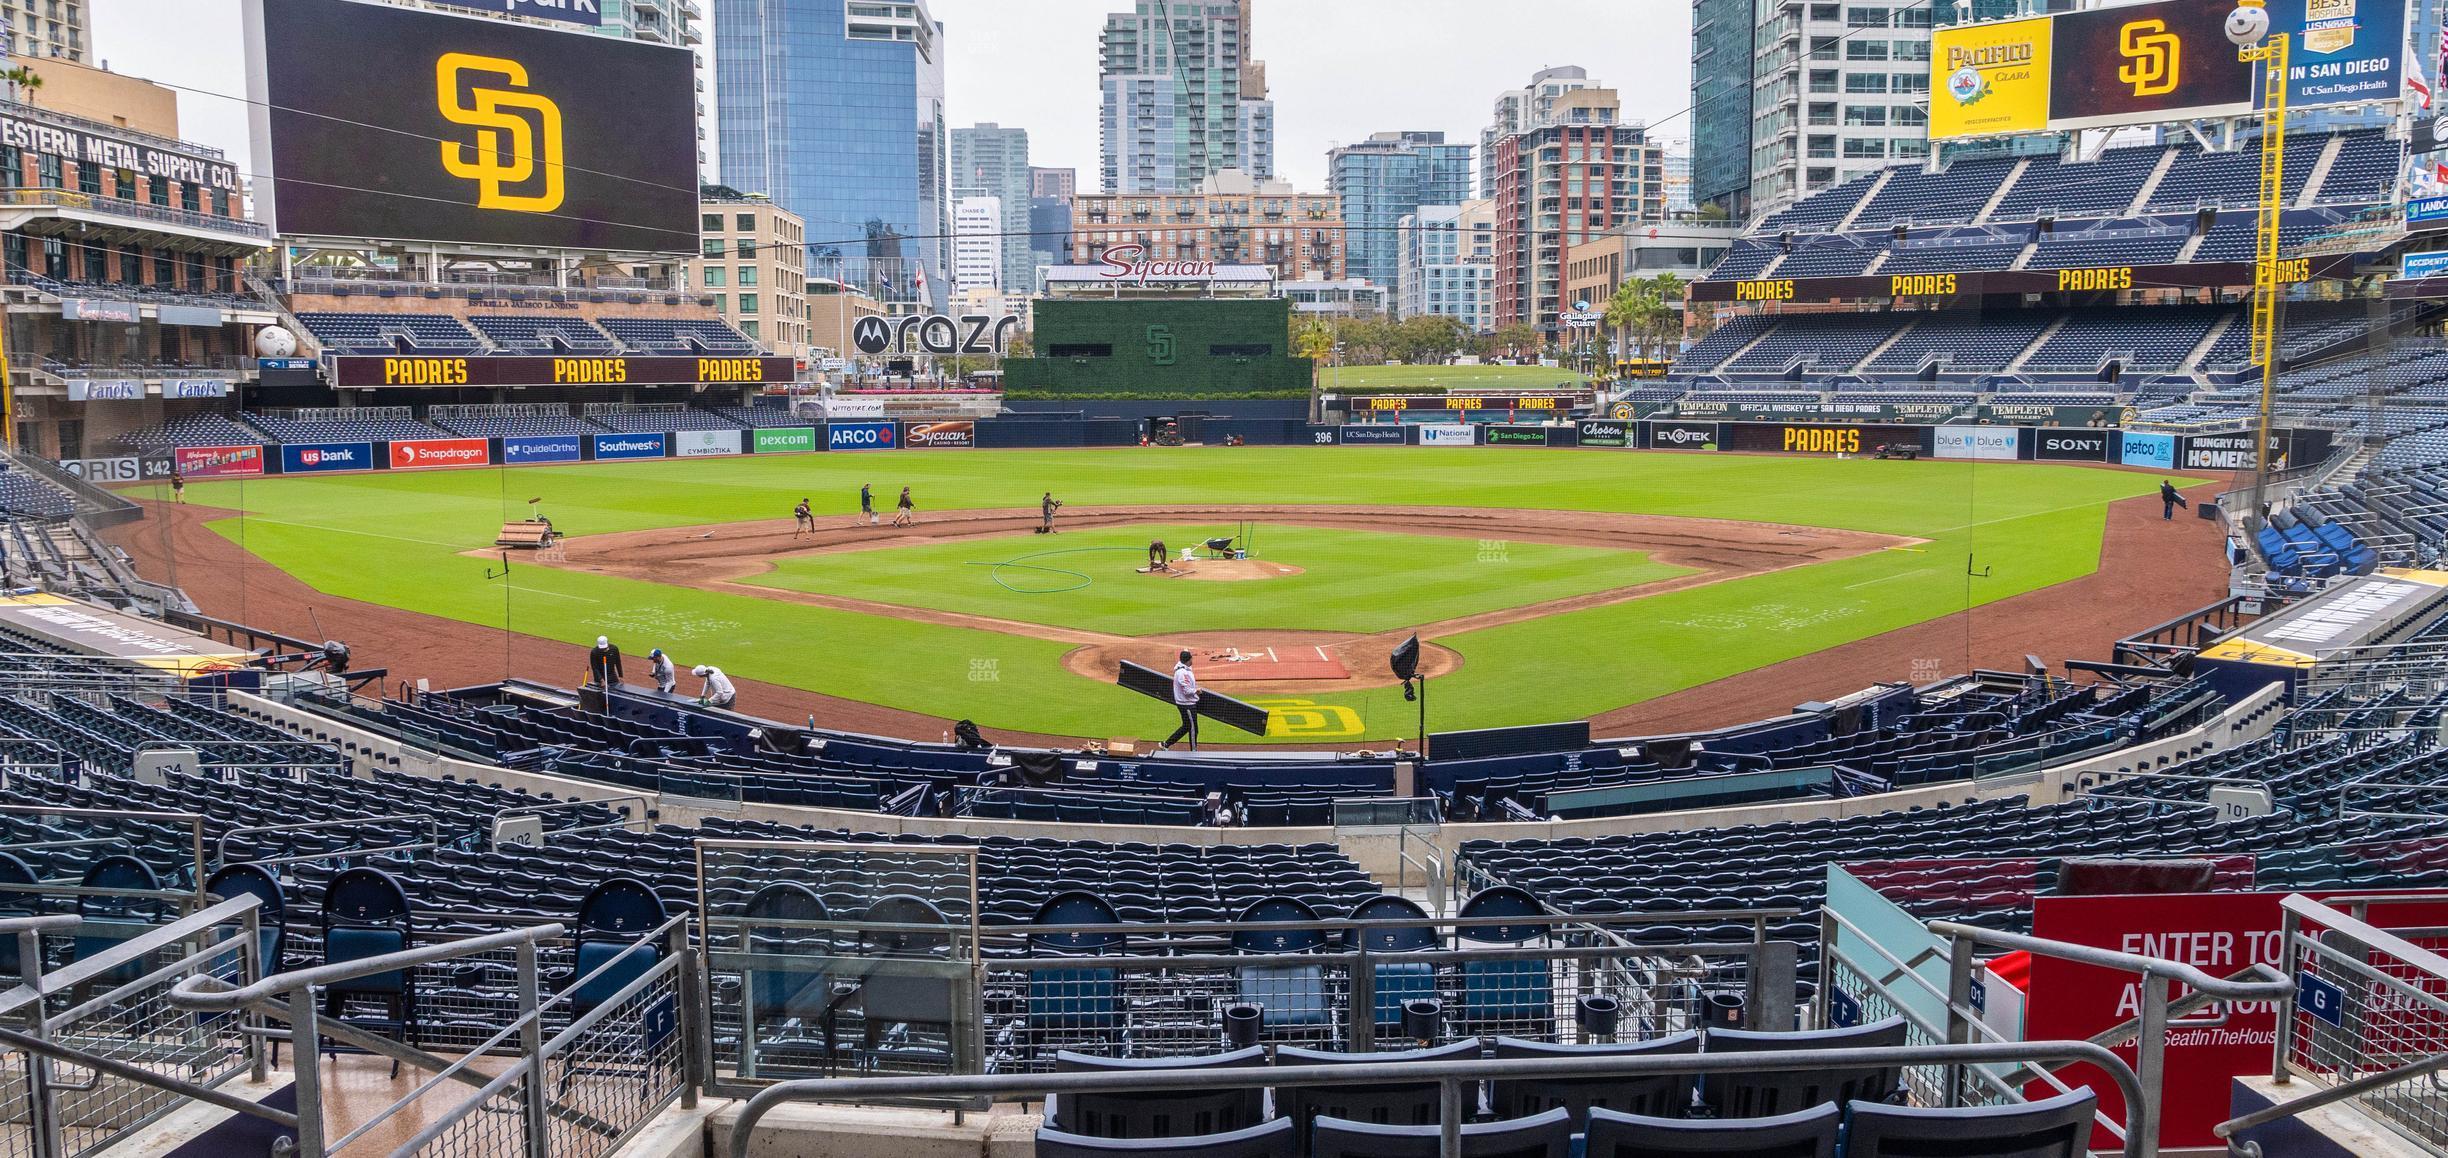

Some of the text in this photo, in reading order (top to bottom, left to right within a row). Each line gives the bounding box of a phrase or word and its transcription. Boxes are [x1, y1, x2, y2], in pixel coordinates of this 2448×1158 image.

[2309, 7, 2352, 19] HOSPITALS
[1947, 42, 2033, 70] PACIFICO
[2290, 66, 2306, 80] IN
[2311, 63, 2341, 78] SAN
[2346, 57, 2390, 75] DIEGO
[1995, 71, 2031, 82] CLARA
[2302, 80, 2388, 96] UC San Diego Health
[1, 117, 237, 190] ESTERN METAL SUPPLY CO.
[1099, 243, 1218, 288] Sycuan
[2257, 258, 2310, 285] PDRES
[1891, 274, 1956, 296] PADRES
[2059, 267, 2132, 291] PADRES
[1737, 280, 1794, 300] PADRES
[469, 300, 579, 310] ESTRELLA JALISCO LANDING
[1560, 312, 1602, 322] Gallagher
[1565, 319, 1596, 329] Square
[896, 315, 1020, 355] razr
[384, 358, 467, 384] PADRES
[554, 359, 626, 383] PADRES
[698, 359, 762, 381] PADRES
[16, 402, 35, 418] 336
[1519, 398, 1555, 410] PADRES
[1678, 402, 1727, 413] TEMPLETON
[1740, 404, 1771, 412] OFFICIAL
[1772, 404, 1803, 412] WHISKEY
[1820, 405, 1834, 413] SAN
[1835, 405, 1854, 413] DIEGO
[1855, 405, 1881, 413] PADRES
[1893, 405, 1953, 416] TEMPLETON
[1991, 406, 2055, 416] TEMPLETON
[908, 424, 968, 446] Sycuan
[1366, 432, 1382, 440] Diego
[1439, 429, 1471, 437] National
[1582, 422, 1623, 435] Chosen
[831, 430, 877, 444] ARCO
[1314, 432, 1332, 443] 396
[1514, 433, 1531, 441] Diego
[1783, 427, 1861, 453] PADRES
[1937, 435, 1962, 446] blue
[1977, 436, 2003, 446] blue
[2193, 437, 2232, 449] HUNGRY
[2233, 438, 2254, 449] FOR
[522, 442, 577, 455] QuidelOrtho
[599, 440, 654, 452] Southwest
[2046, 439, 2102, 451] SONY
[2124, 440, 2155, 457] petco
[303, 449, 353, 463] us bank
[419, 448, 483, 460] Snapdragon
[2187, 450, 2258, 469] HOMERS
[145, 459, 171, 476] 342
[2226, 802, 2250, 818] 101
[2121, 931, 2234, 967] ENTER
[2244, 930, 2284, 966] TO
[2314, 989, 2327, 1010] G
[1841, 1002, 1848, 1021] F
[657, 1010, 664, 1032] F
